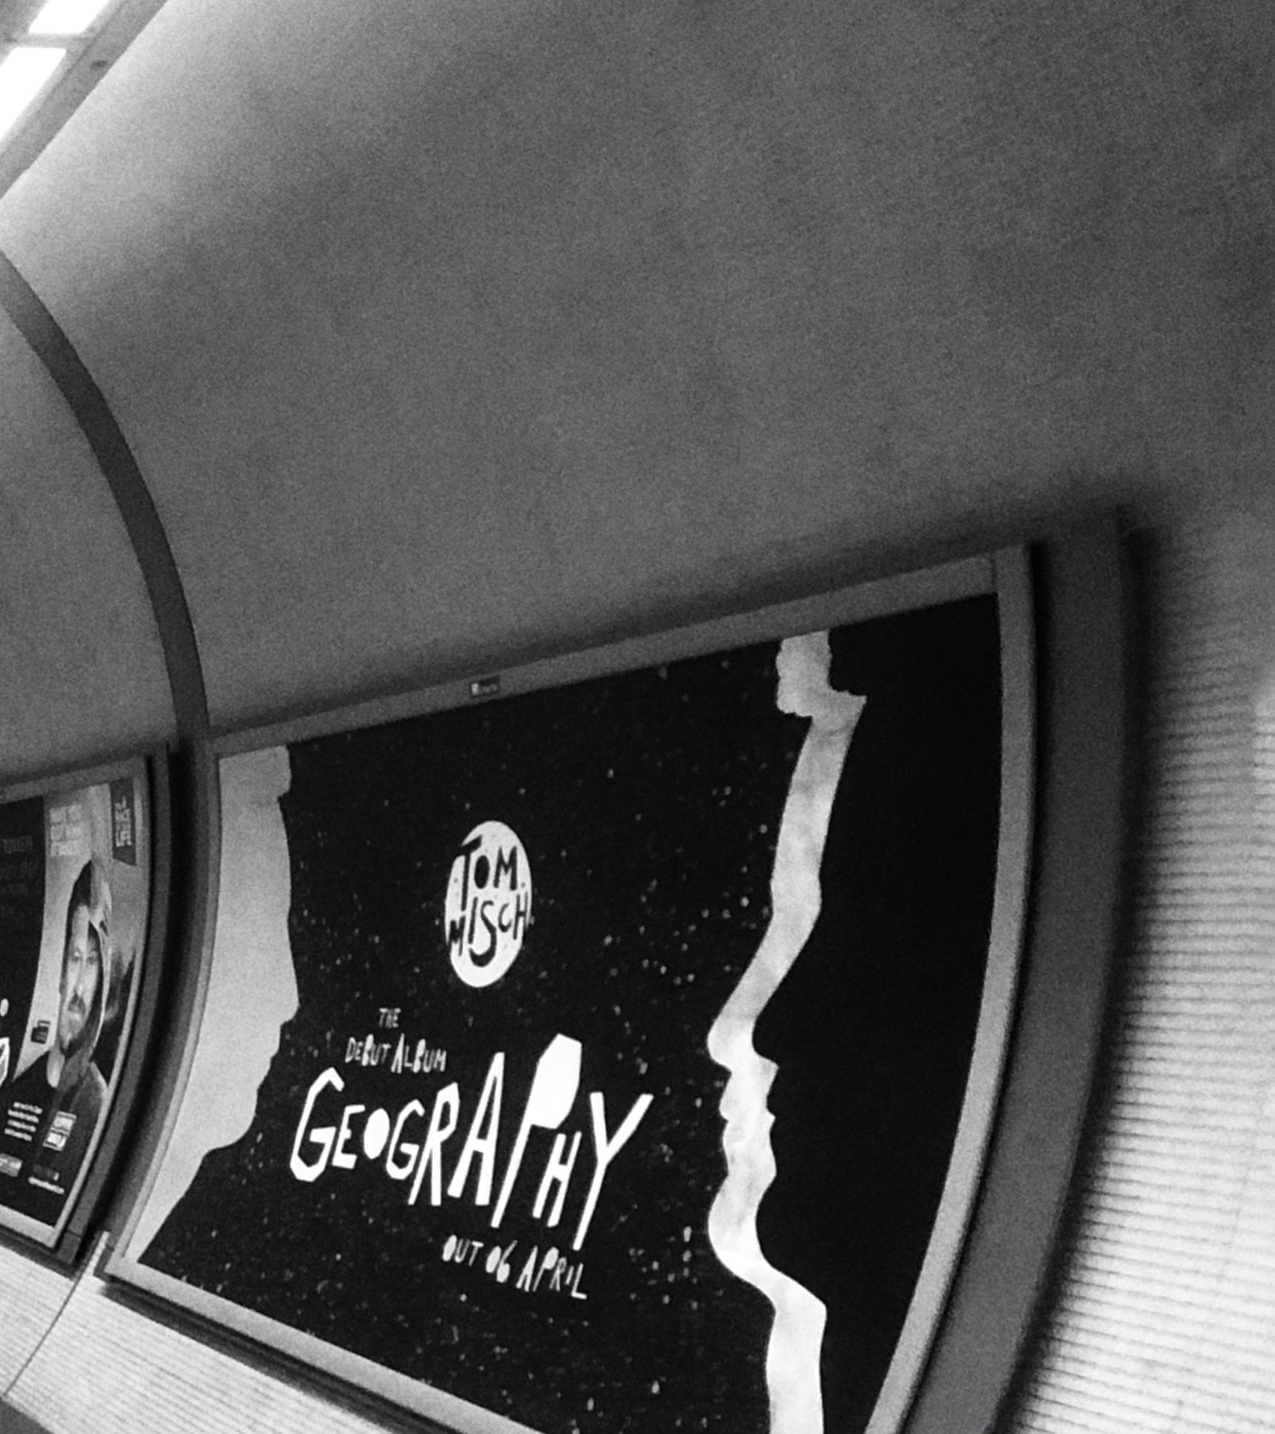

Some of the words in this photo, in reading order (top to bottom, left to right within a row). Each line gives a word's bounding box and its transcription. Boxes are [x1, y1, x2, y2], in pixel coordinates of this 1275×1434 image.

[460, 834, 518, 912] TOM
[449, 890, 529, 968] MISCH
[344, 1032, 393, 1068] DEBUT
[390, 1032, 448, 1075] ALBUM
[378, 1007, 403, 1030] THE
[289, 1031, 655, 1252] GEOGRAPHY
[441, 1233, 486, 1267] OUT
[485, 1239, 519, 1284] 06
[515, 1243, 588, 1300] APRIL
